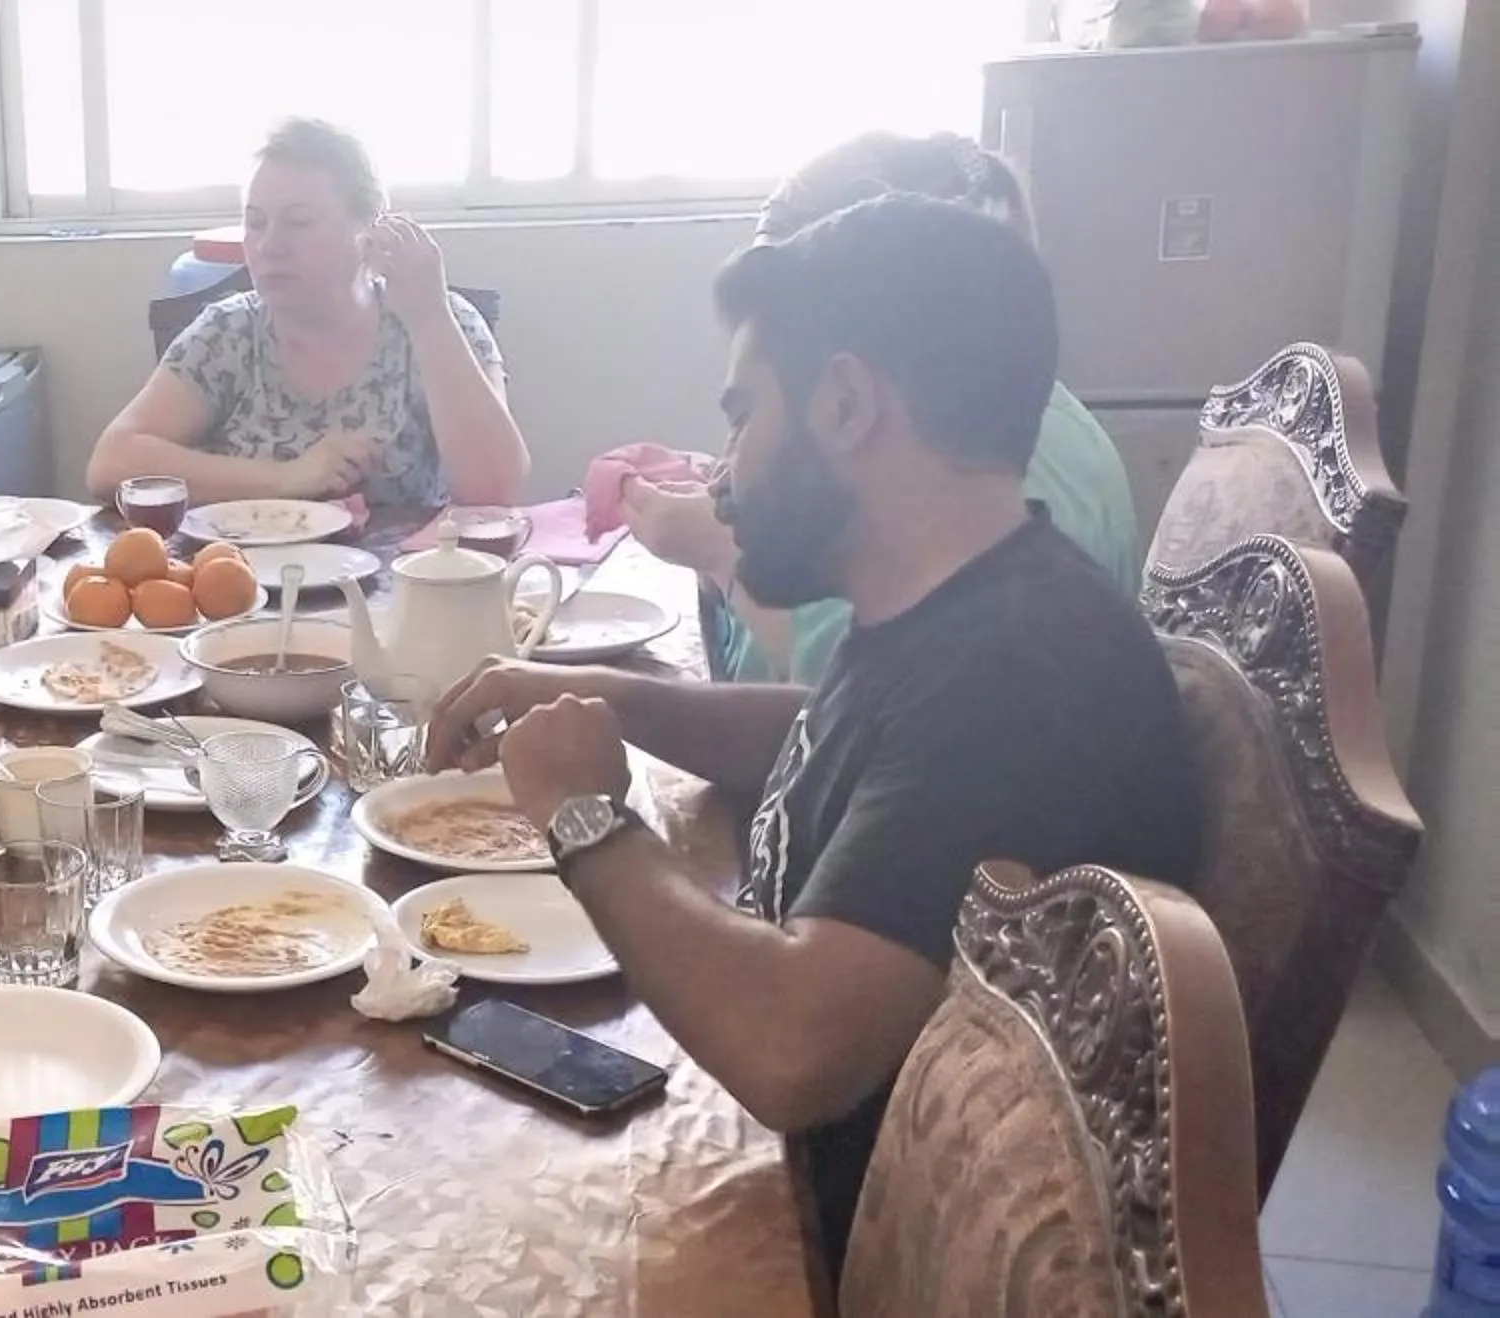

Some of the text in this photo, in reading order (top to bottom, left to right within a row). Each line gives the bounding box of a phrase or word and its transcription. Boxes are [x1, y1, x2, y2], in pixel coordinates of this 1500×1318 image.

[23, 1299, 72, 1318] Highly
[77, 1282, 162, 1312] Absorbent
[168, 1273, 228, 1295] Tissues
